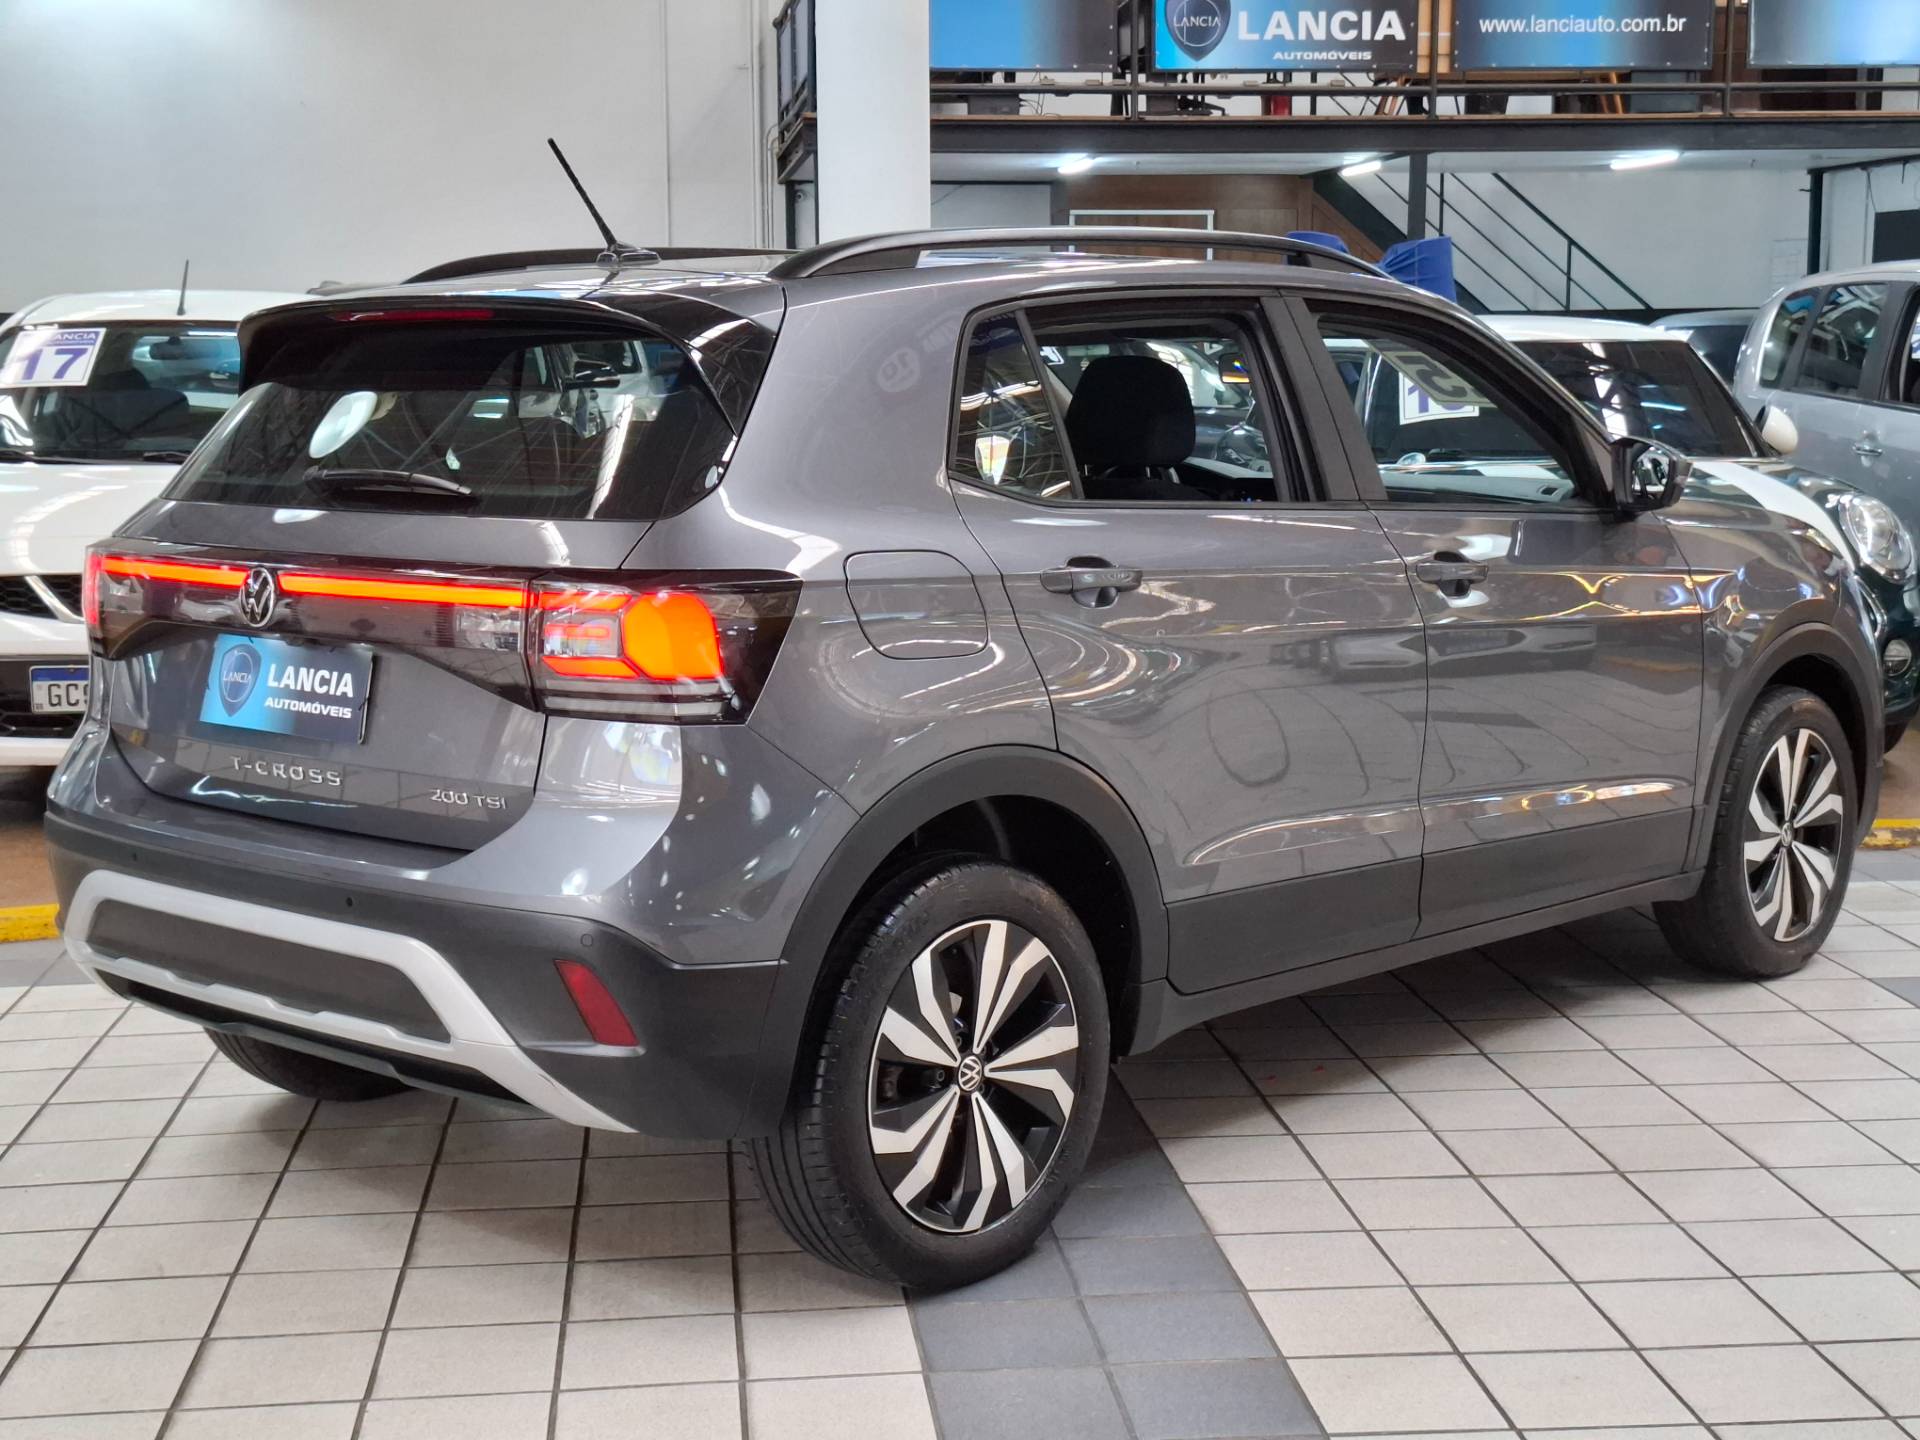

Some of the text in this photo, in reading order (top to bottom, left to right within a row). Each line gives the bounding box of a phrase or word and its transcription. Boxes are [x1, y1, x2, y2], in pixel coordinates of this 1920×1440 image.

[1173, 16, 1221, 27] LANCIA
[1238, 10, 1406, 41] LANCIA
[1479, 13, 1687, 33] www.lanciauto.com.br
[1273, 50, 1373, 61] AUTOMÓVEIS
[52, 332, 96, 340] ANCIA
[19, 347, 89, 381] 17
[222, 671, 252, 684] LANCIA
[267, 663, 354, 698] LANCIA
[264, 696, 353, 719] AUTOMÓVEIS
[230, 755, 342, 786] T-CROSS
[429, 788, 507, 810] 200 TSI
